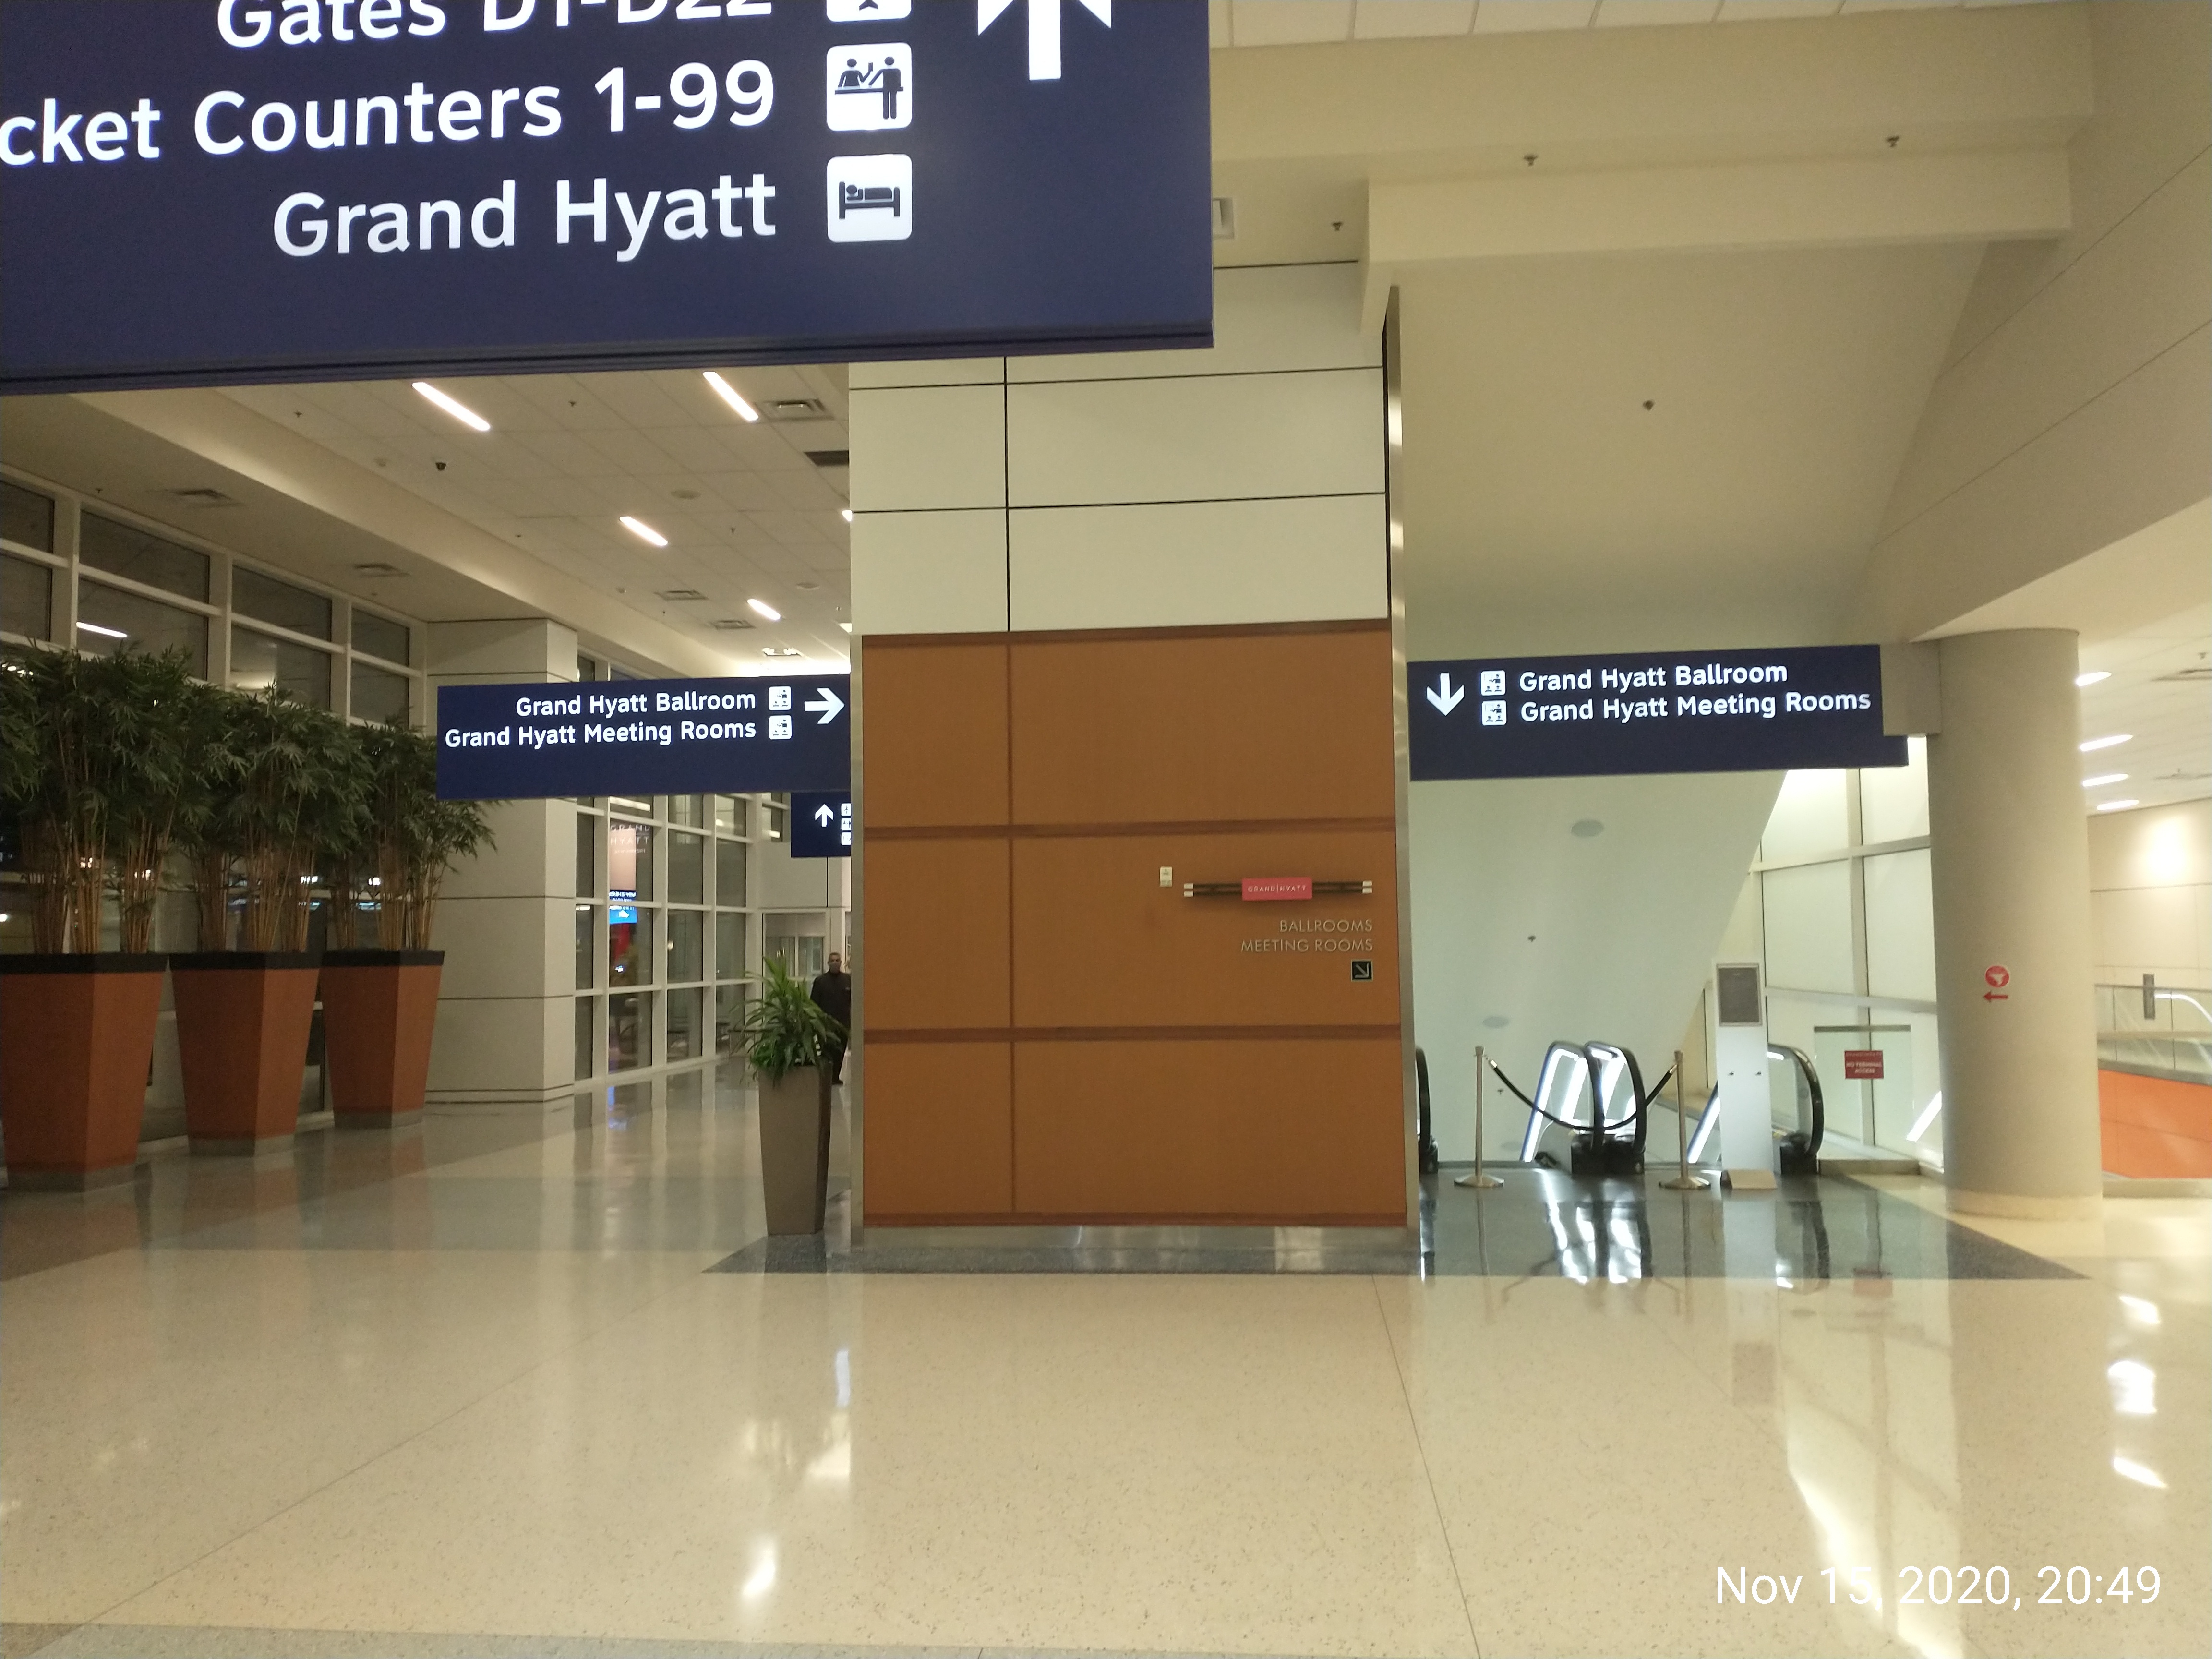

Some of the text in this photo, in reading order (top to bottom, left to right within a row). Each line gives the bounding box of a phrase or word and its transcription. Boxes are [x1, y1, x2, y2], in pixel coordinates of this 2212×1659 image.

[218, 0, 445, 48] Gates
[195, 83, 561, 155] Counters
[595, 60, 773, 132] 1-99
[274, 174, 775, 262] Grand Hyatt
[1520, 663, 1787, 693] Grand Hyatt Ballroom
[517, 691, 755, 718] Grand Hyatt Ballroom
[1521, 692, 1871, 723] Grand Hyatt Meeting Rooms
[445, 721, 756, 749] Grand Hyatt Meeting Rooms
[1279, 919, 1372, 932] BALLROOMS
[1241, 939, 1373, 952] MEETING ROOMS
